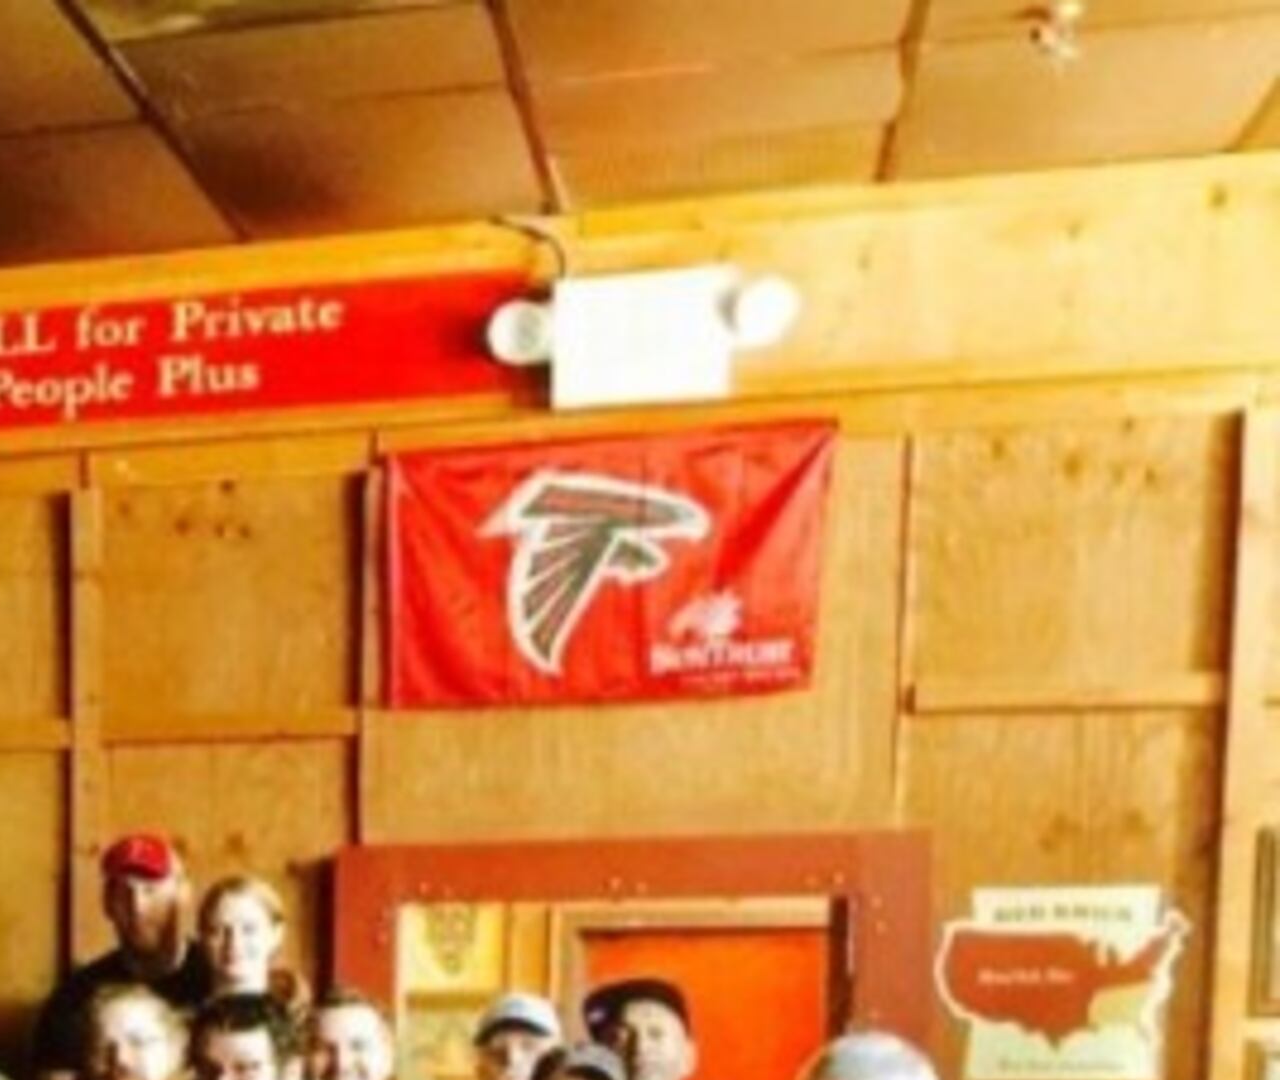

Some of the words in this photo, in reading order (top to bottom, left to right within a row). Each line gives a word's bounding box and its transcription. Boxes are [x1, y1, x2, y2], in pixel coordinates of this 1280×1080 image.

[75, 302, 147, 351] for
[169, 297, 345, 342] Private
[156, 353, 261, 397] Plus
